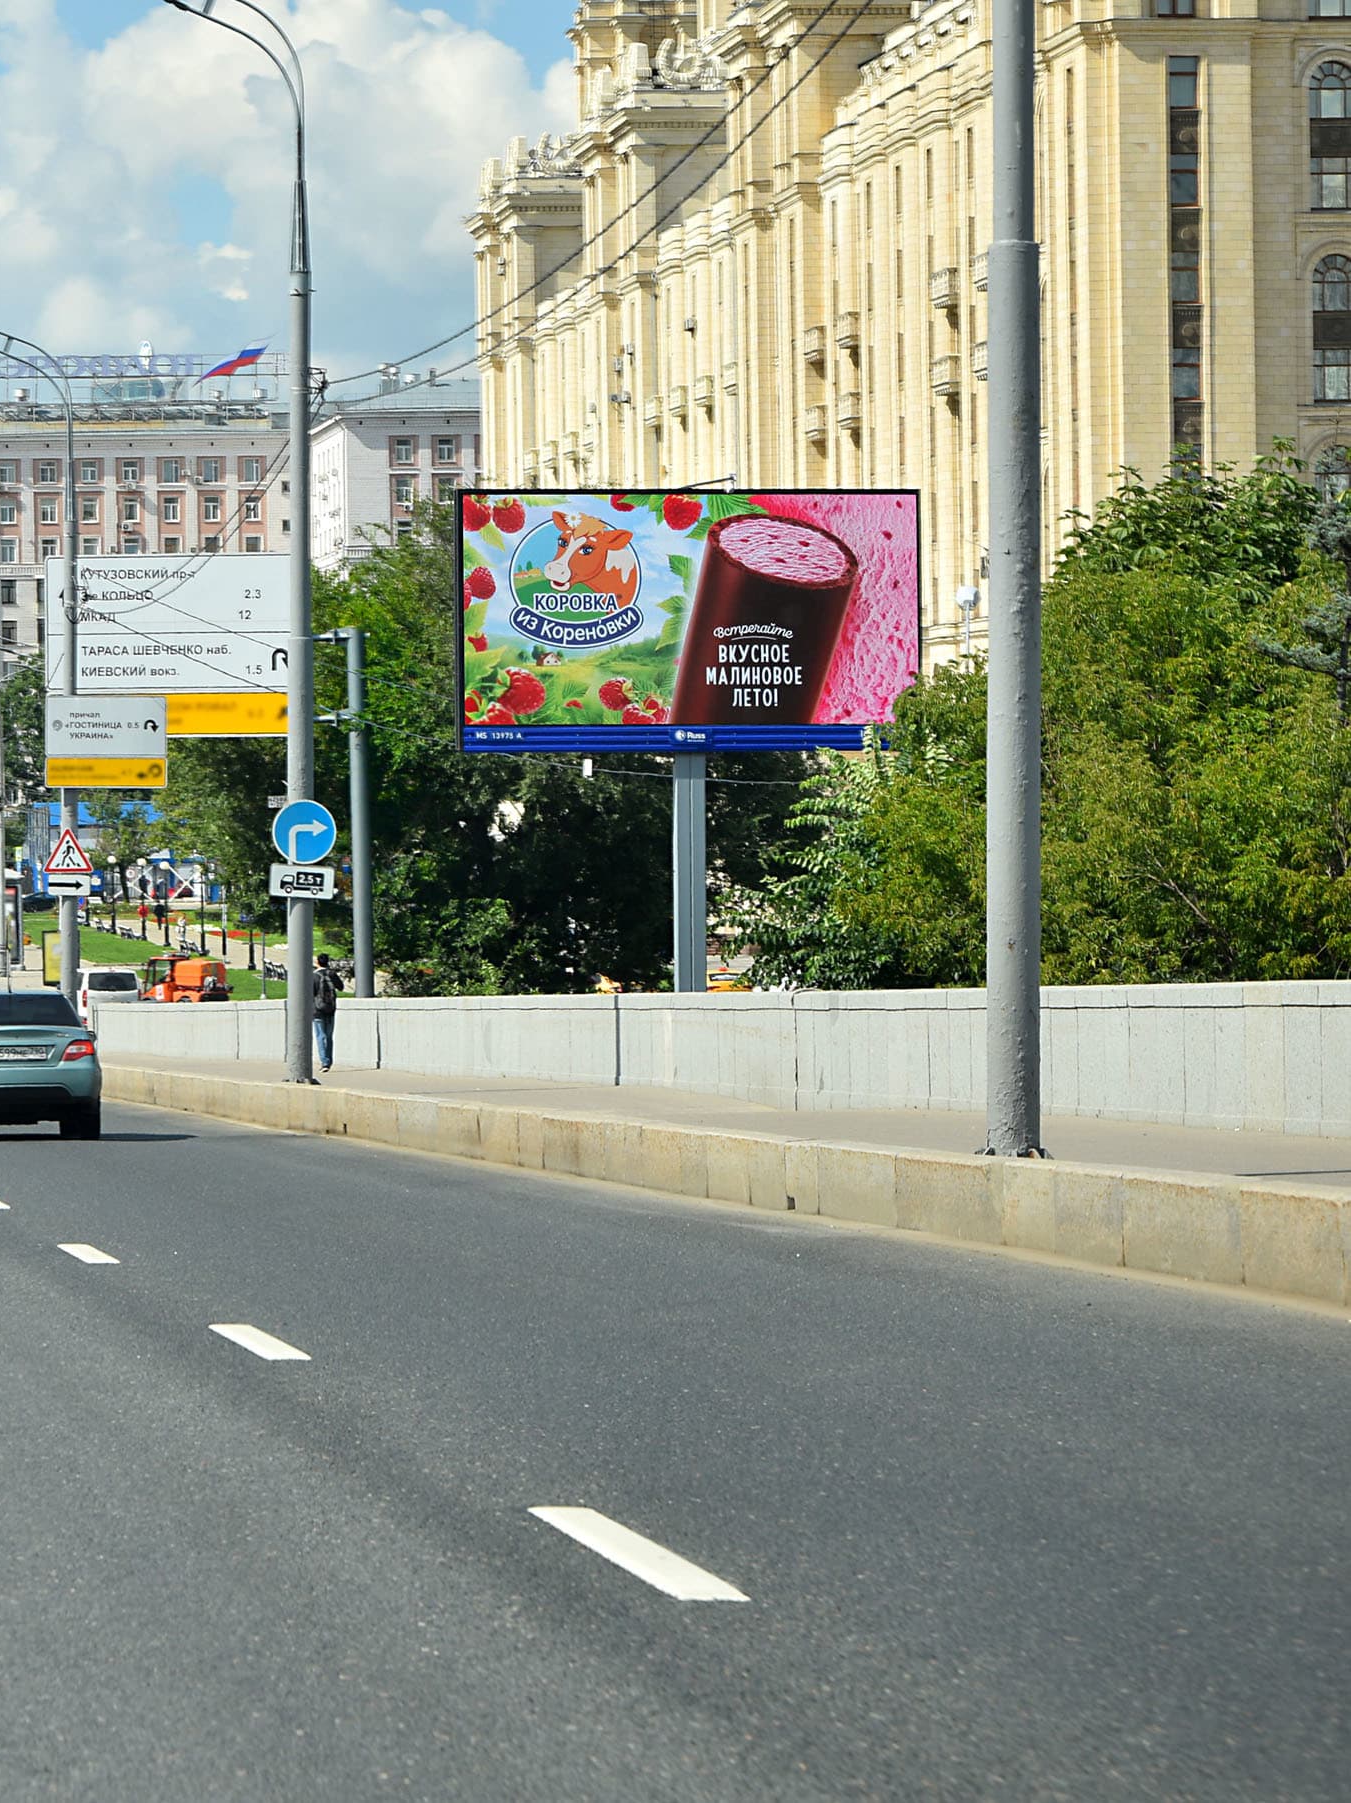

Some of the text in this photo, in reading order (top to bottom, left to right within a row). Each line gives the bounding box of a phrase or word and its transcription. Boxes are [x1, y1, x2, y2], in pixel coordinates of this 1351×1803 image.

[80, 567, 169, 580] КУТУЗОВСКИЙ
[244, 589, 262, 599] 2.3
[534, 594, 618, 611] КОРОВКА
[238, 610, 252, 620] 12
[713, 622, 794, 639] Встречайте
[82, 645, 232, 656] ТАРАСА ШЕВЧЕНКО наб.
[718, 644, 790, 663] ВКУСНОЕ
[81, 664, 146, 677] КИЕВСКИЙ
[247, 665, 263, 675] 1.5
[706, 666, 803, 685] МАЛИНОВОЕ
[732, 688, 779, 707] ЛЕТО!
